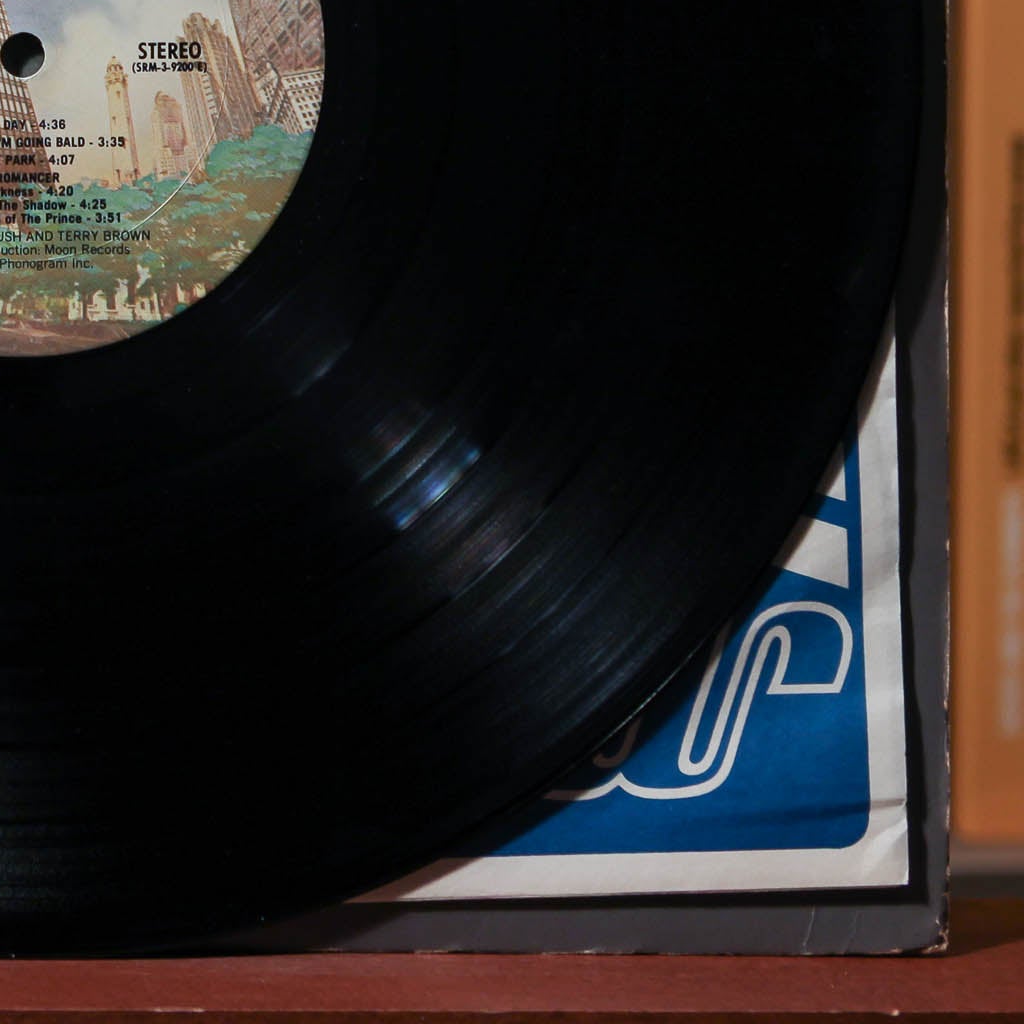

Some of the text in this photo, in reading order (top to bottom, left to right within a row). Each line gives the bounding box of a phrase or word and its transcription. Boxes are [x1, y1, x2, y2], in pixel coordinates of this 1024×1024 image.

[138, 41, 202, 60] STEREO
[3, 119, 27, 131] DAY
[39, 119, 66, 130] 4:36
[16, 137, 51, 148] GOING
[56, 137, 86, 148] BALD
[98, 136, 125, 147] 3:35
[5, 155, 36, 166] PARK
[49, 154, 75, 165] 4:07
[46, 186, 74, 196] 4:20
[23, 199, 67, 210] Shadow
[79, 199, 107, 209] 4:25
[5, 213, 16, 224] of
[21, 213, 41, 224] The
[45, 213, 82, 224] Prince
[95, 212, 121, 223] 3:51
[26, 231, 54, 242] AND
[57, 230, 98, 242] TERRY
[103, 230, 151, 241] BROWN
[44, 244, 77, 255] Moon
[81, 244, 130, 255] Records
[0, 258, 69, 273] Phonogram
[72, 257, 94, 270] Inc.
